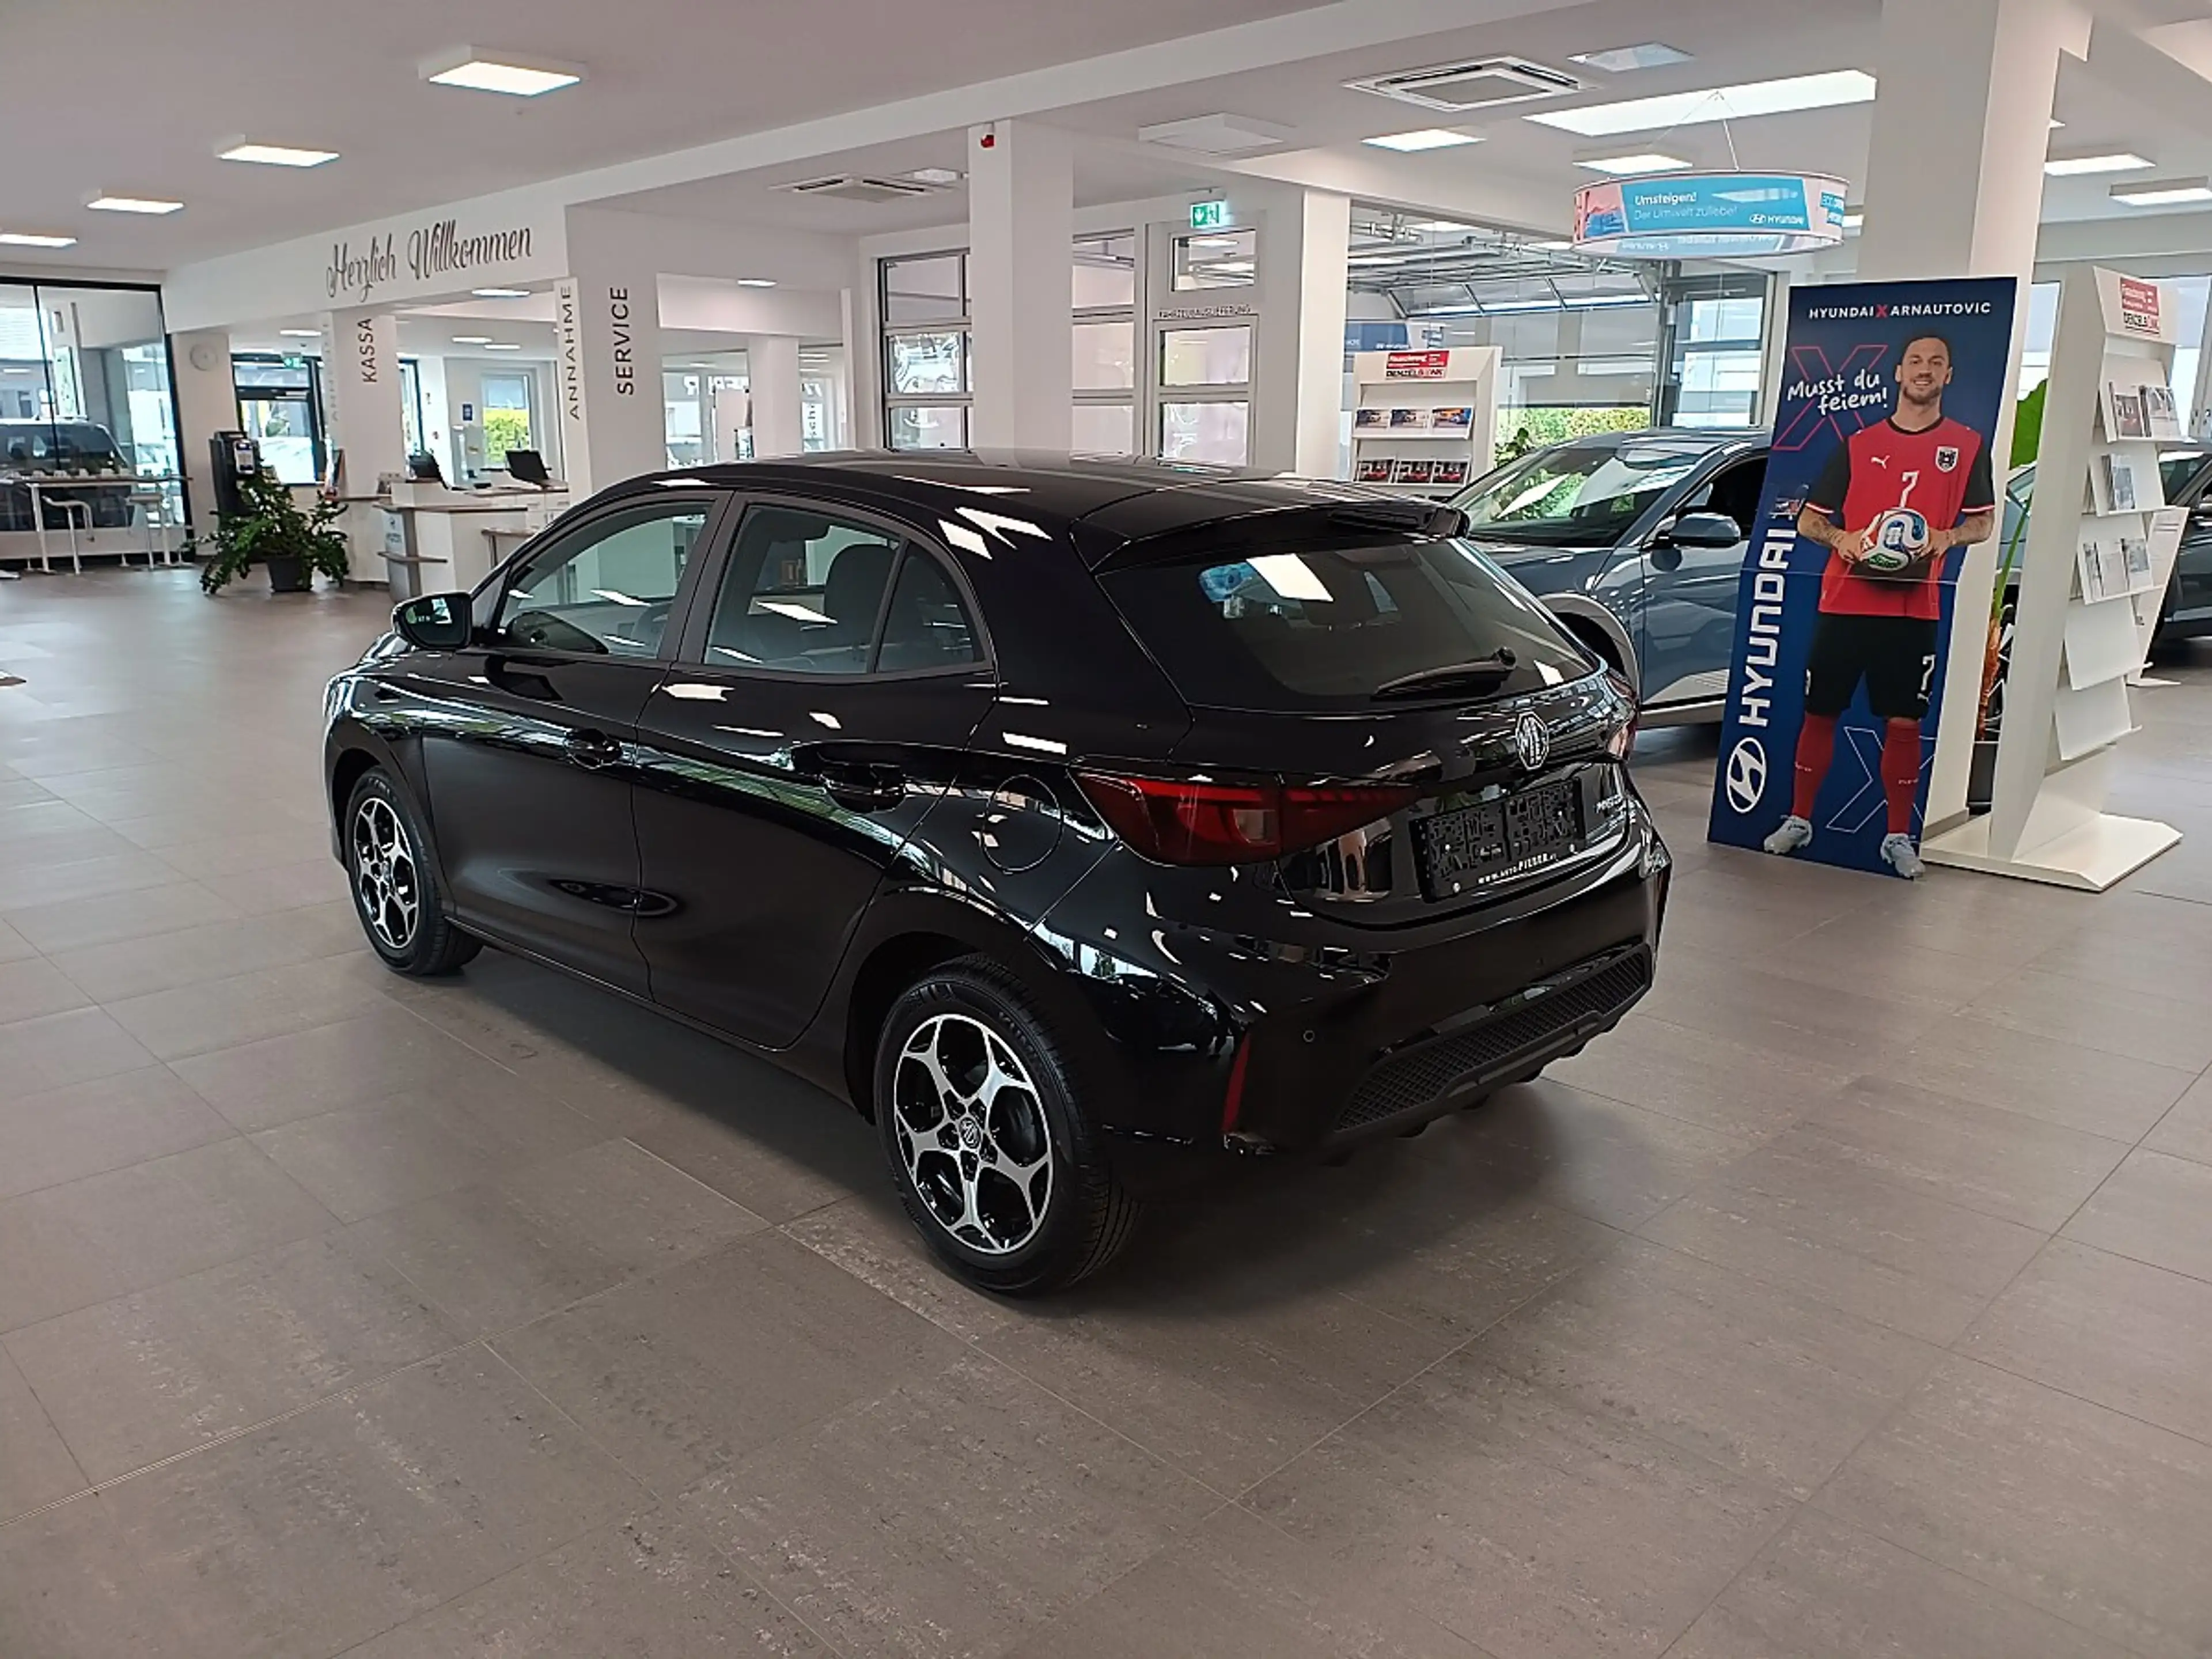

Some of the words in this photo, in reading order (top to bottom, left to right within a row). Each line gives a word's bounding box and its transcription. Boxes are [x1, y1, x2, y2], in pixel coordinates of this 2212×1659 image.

[1634, 191, 1697, 206] Umsteigen!
[1634, 208, 1650, 221] Der
[326, 233, 397, 303] Herzlich
[407, 218, 532, 281] Willkommen
[1808, 307, 1874, 320] HYUNDAI
[1890, 301, 1991, 317] ARNAUTOVIC
[357, 317, 378, 383] KASSA
[559, 285, 581, 421] ANNAHME
[609, 286, 635, 396] SERVICE
[1787, 373, 1846, 402] Musst
[1854, 368, 1880, 389] du
[1817, 388, 1888, 416] feiern!
[1902, 469, 1921, 508] 7
[1738, 528, 1798, 728] HYUNDAI
[1921, 653, 1936, 691] 7
